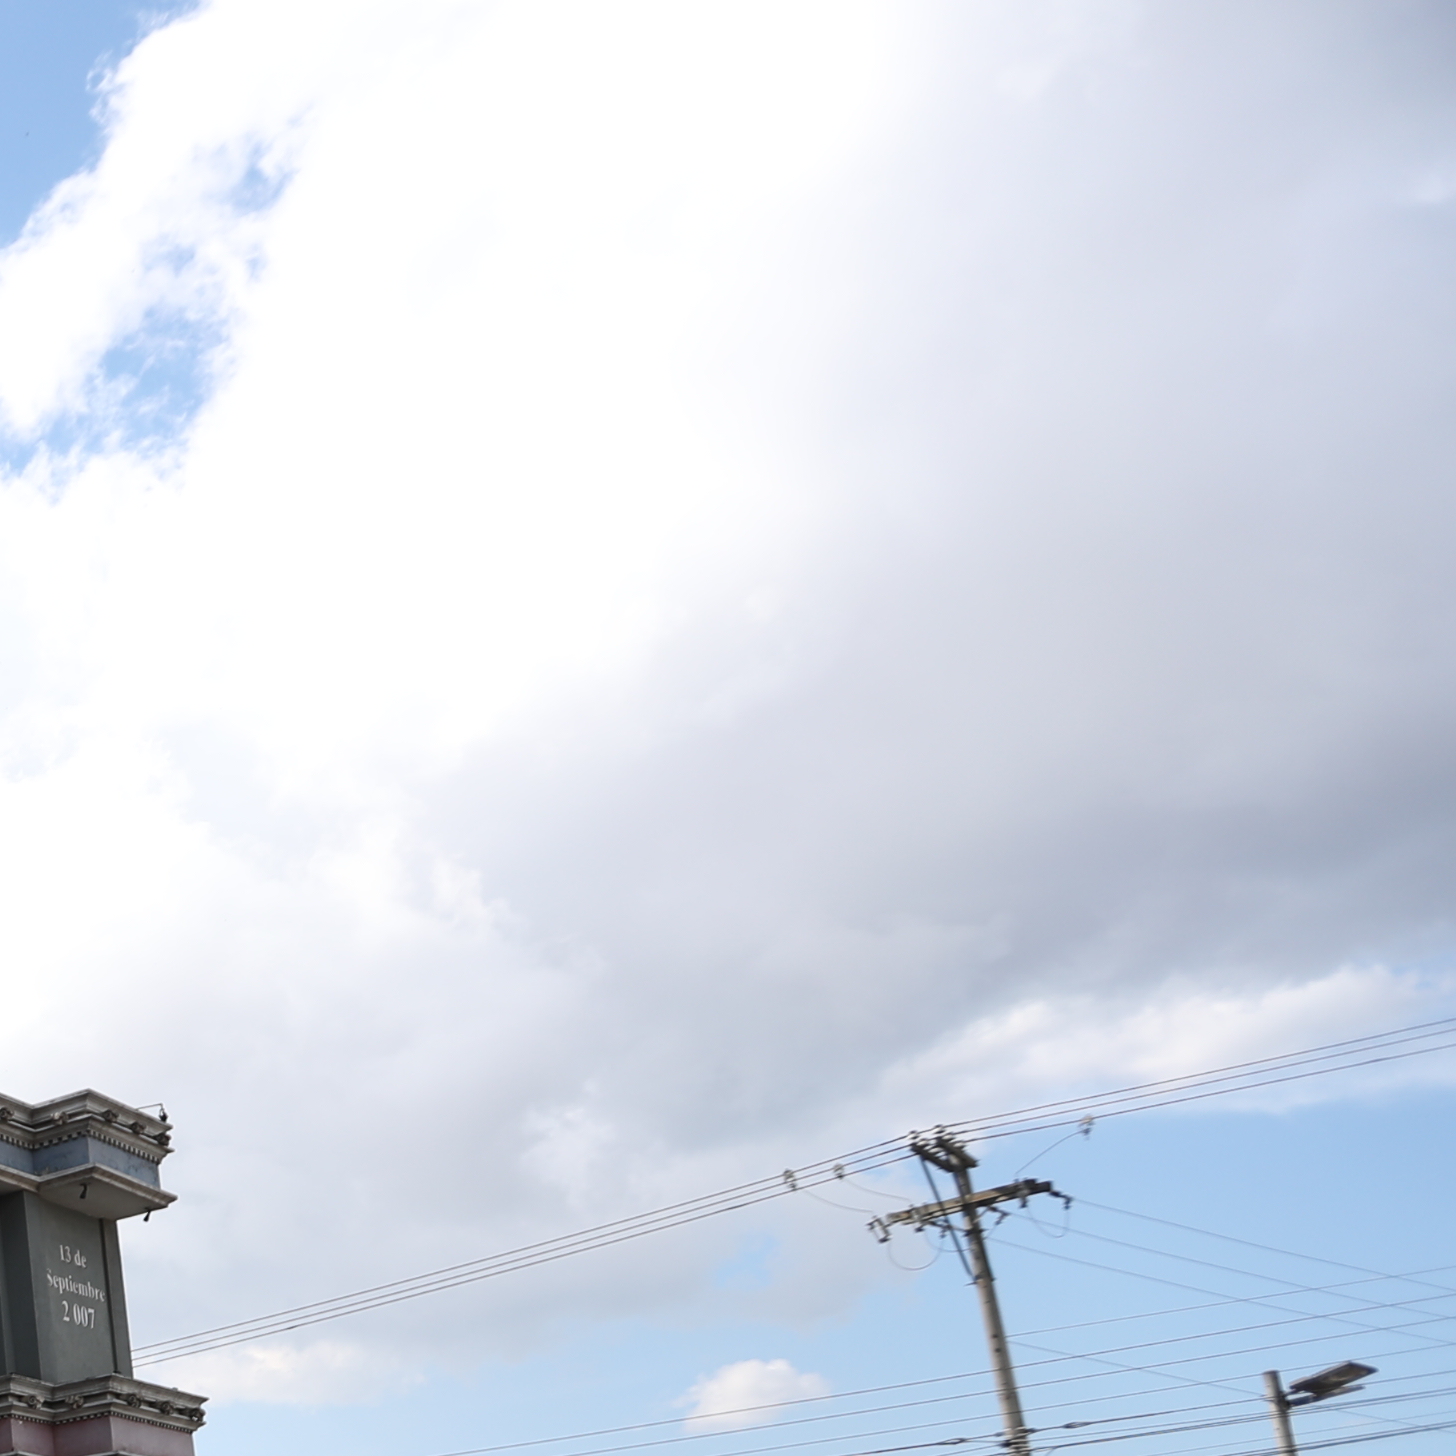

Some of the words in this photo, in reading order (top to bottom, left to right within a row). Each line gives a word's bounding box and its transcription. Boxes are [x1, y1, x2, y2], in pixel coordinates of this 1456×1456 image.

[59, 1244, 72, 1263] 13
[74, 1249, 87, 1268] de
[46, 1268, 106, 1302] Septiembre
